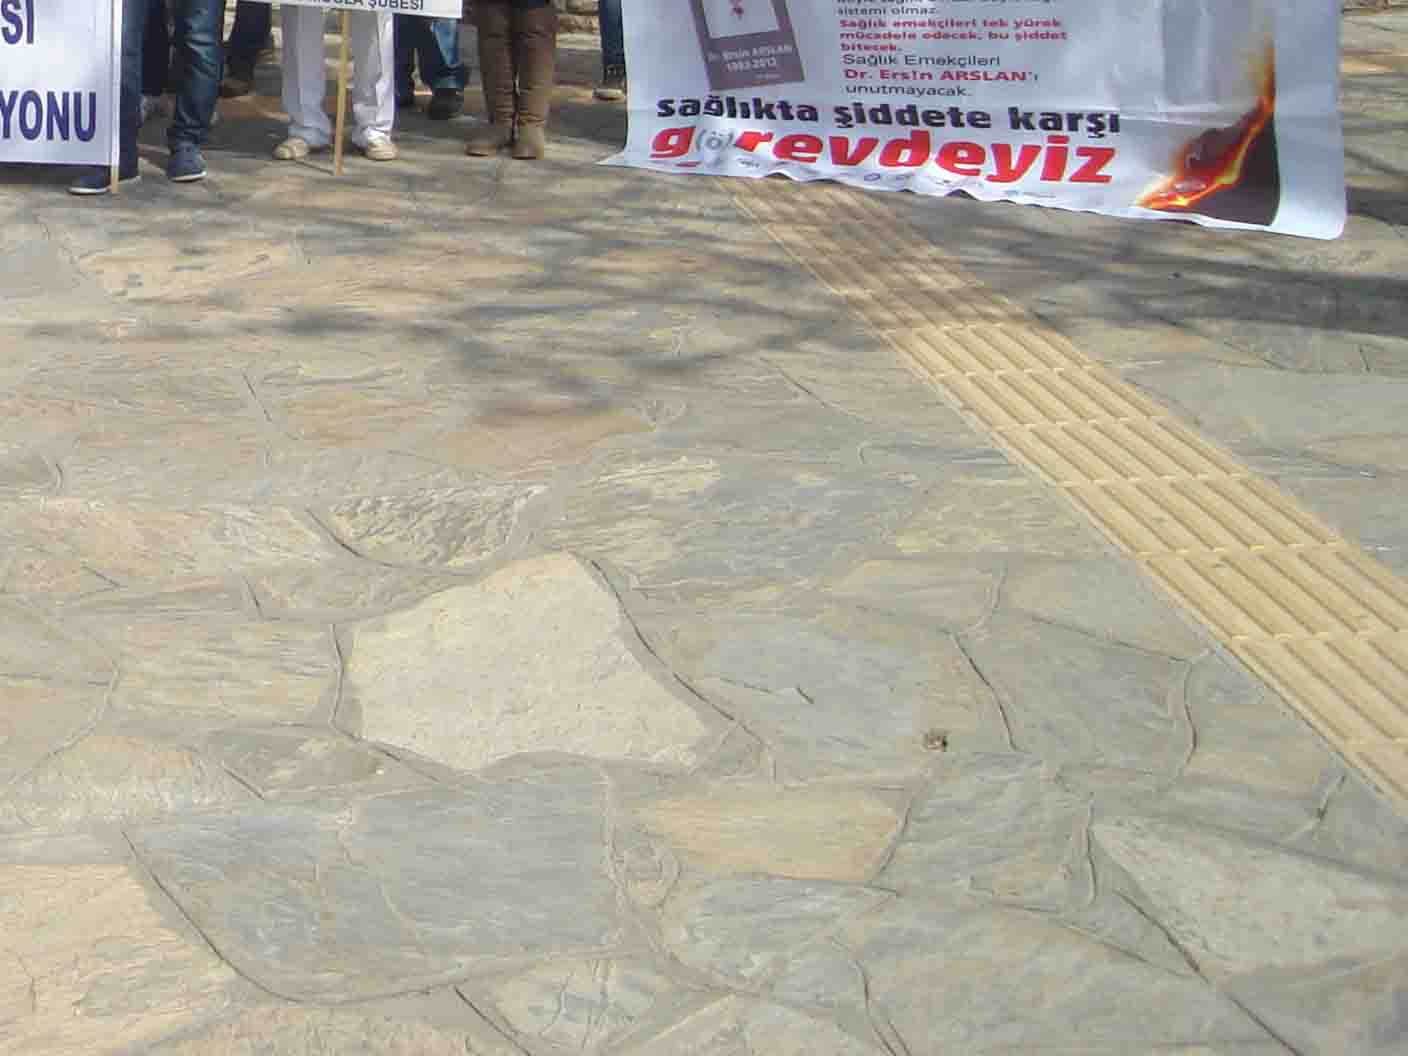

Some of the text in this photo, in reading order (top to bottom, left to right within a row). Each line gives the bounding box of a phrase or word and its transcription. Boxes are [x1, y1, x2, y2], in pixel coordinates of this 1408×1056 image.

[842, 54, 897, 67] Sağlık
[657, 95, 1120, 138] sağlıkta şiddete karşı
